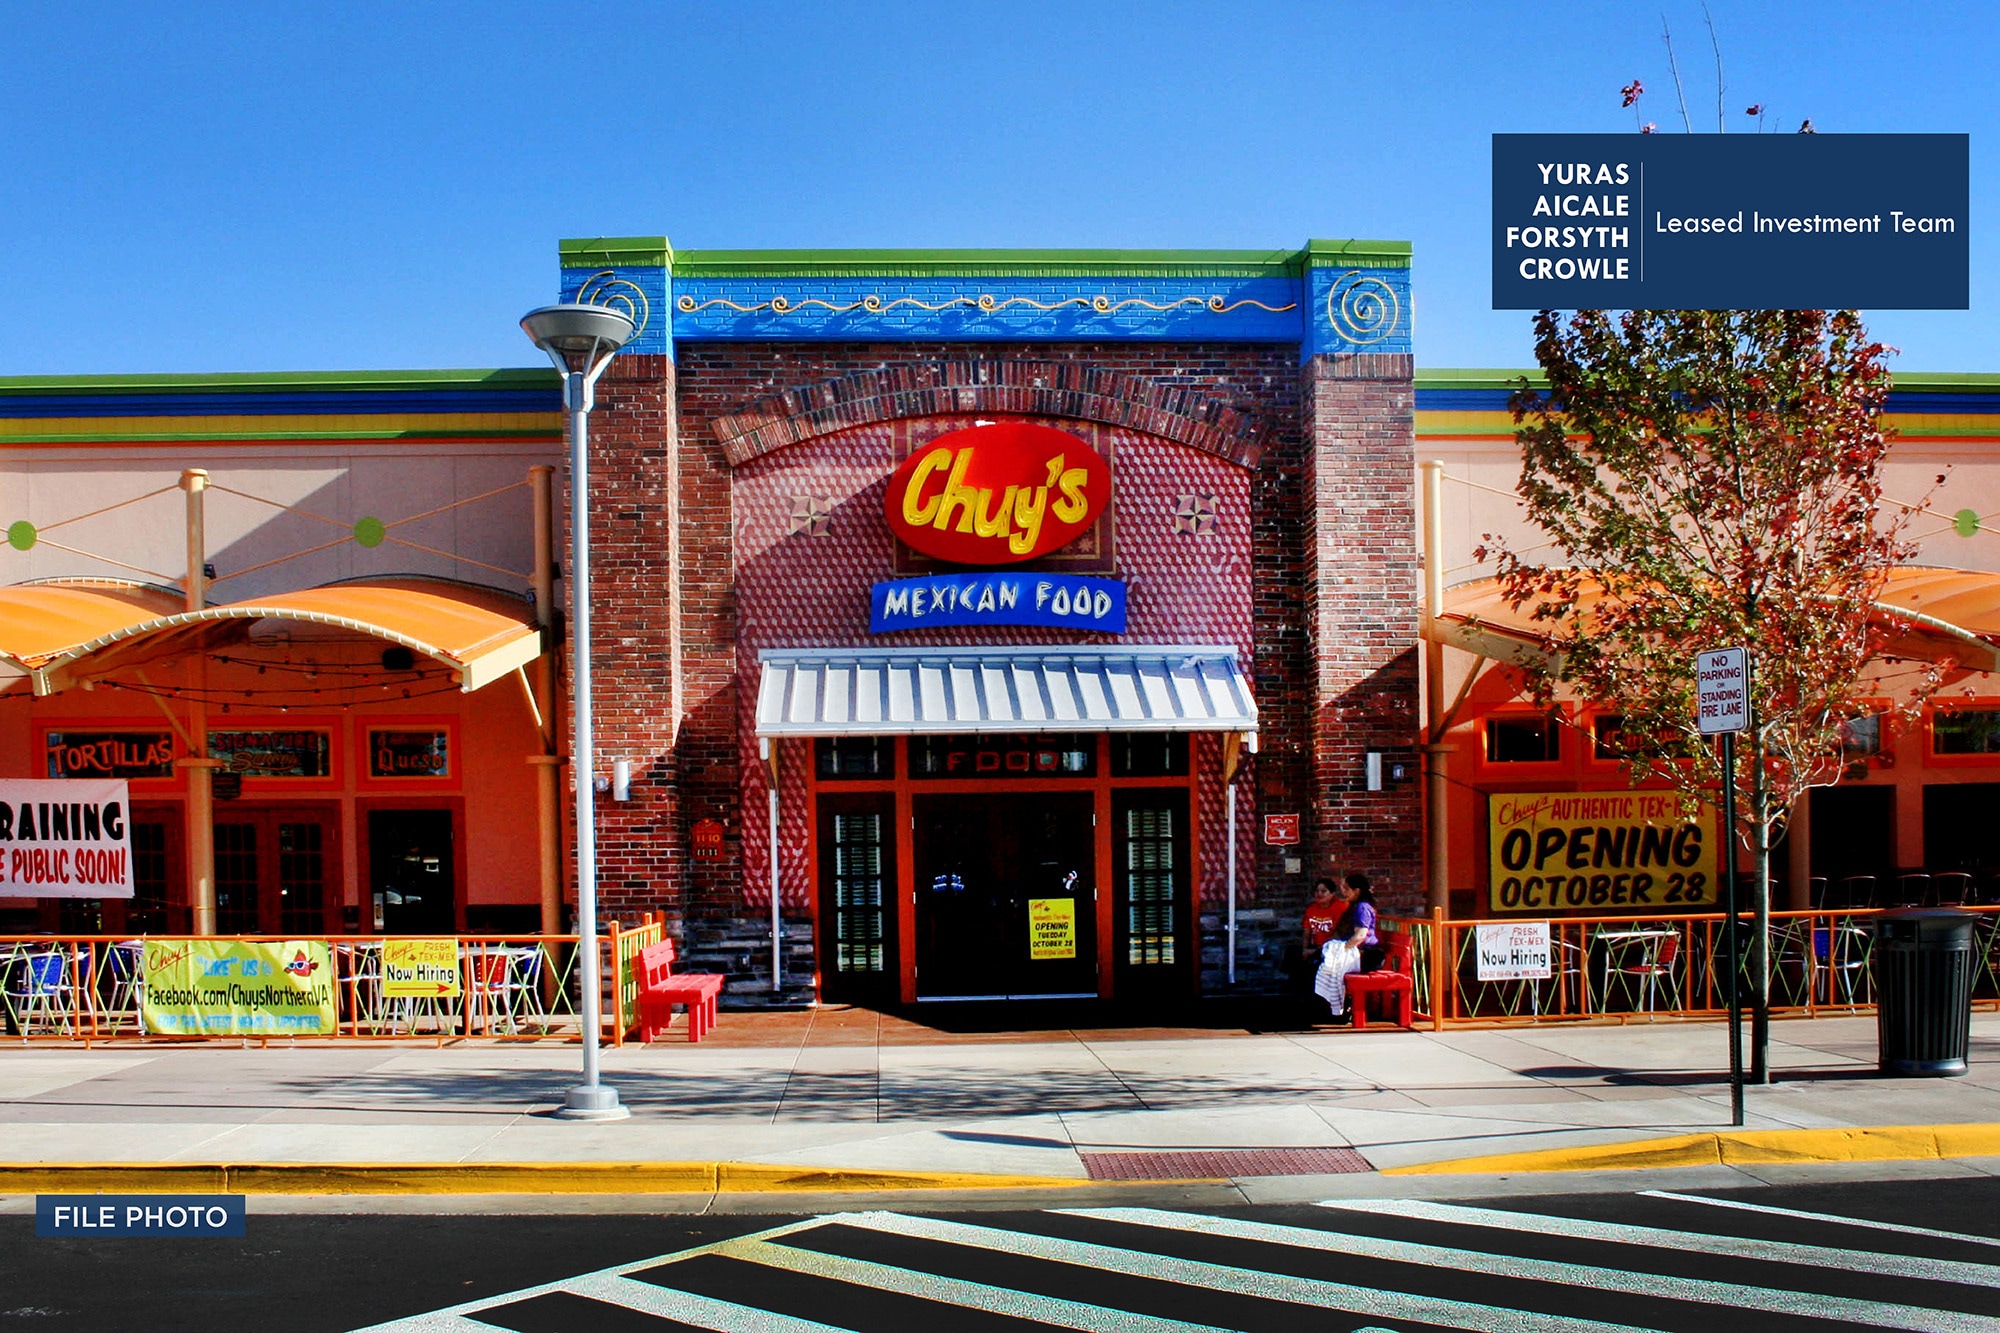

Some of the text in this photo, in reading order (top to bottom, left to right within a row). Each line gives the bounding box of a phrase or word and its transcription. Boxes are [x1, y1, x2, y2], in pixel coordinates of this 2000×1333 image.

[902, 447, 1089, 555] Chuy's
[884, 581, 1112, 620] MEXICAN FOOD
[1712, 656, 1728, 667] NO
[1700, 667, 1741, 681] PARKING
[1701, 689, 1742, 703] STANDING
[1701, 702, 1742, 718] FIRE LANE
[214, 732, 318, 751] SIGNATURE
[48, 740, 173, 775] TORTILLAS
[378, 746, 444, 772] Queso
[947, 752, 1060, 771] FOOD
[1499, 796, 1554, 834] Chuy's
[1551, 797, 1633, 821] AUTHENTIC
[1501, 825, 1702, 871] OPENING
[12, 848, 70, 884] PUBLIC
[75, 847, 127, 885] SOON!
[1501, 872, 1707, 908] OCTOBER 28
[1035, 922, 1068, 930] OPENING
[1512, 927, 1539, 937] FRESH
[424, 942, 450, 952] FRESH
[1508, 936, 1545, 947] TEX-MEX
[419, 951, 456, 962] TEX-MEX
[1482, 949, 1546, 968] Now Hiring
[242, 959, 258, 977] US
[386, 964, 454, 984] Now Hiring
[147, 983, 330, 1011] Facebook.com/ChuysNorthernVA
